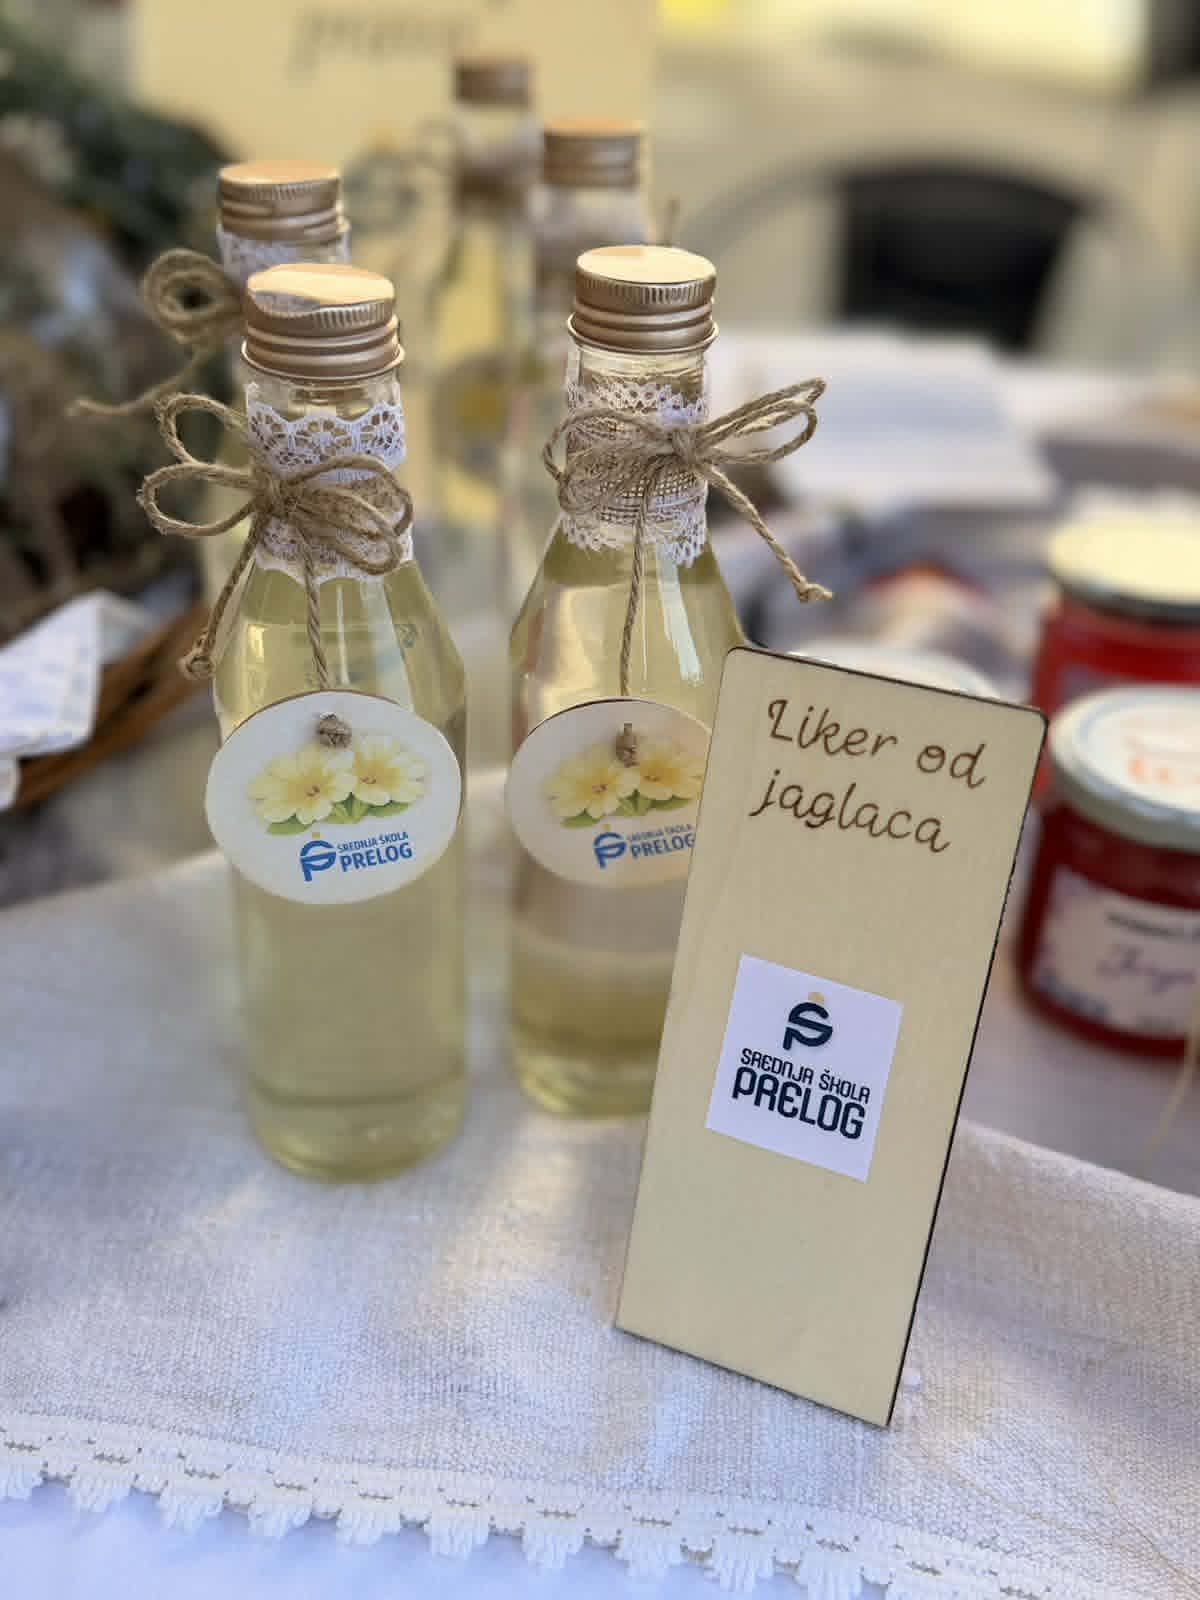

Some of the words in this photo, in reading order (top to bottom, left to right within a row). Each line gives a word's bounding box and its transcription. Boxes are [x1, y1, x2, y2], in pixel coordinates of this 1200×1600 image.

[767, 699, 898, 757] Liker
[916, 743, 986, 789] od
[749, 768, 951, 853] jaglaca
[340, 842, 413, 872] PRELOG
[630, 833, 696, 859] PRELOG
[731, 1066, 866, 1140] PRELOG
[740, 1047, 814, 1086] SREDNJA
[818, 1067, 871, 1105] ŠKOLA
